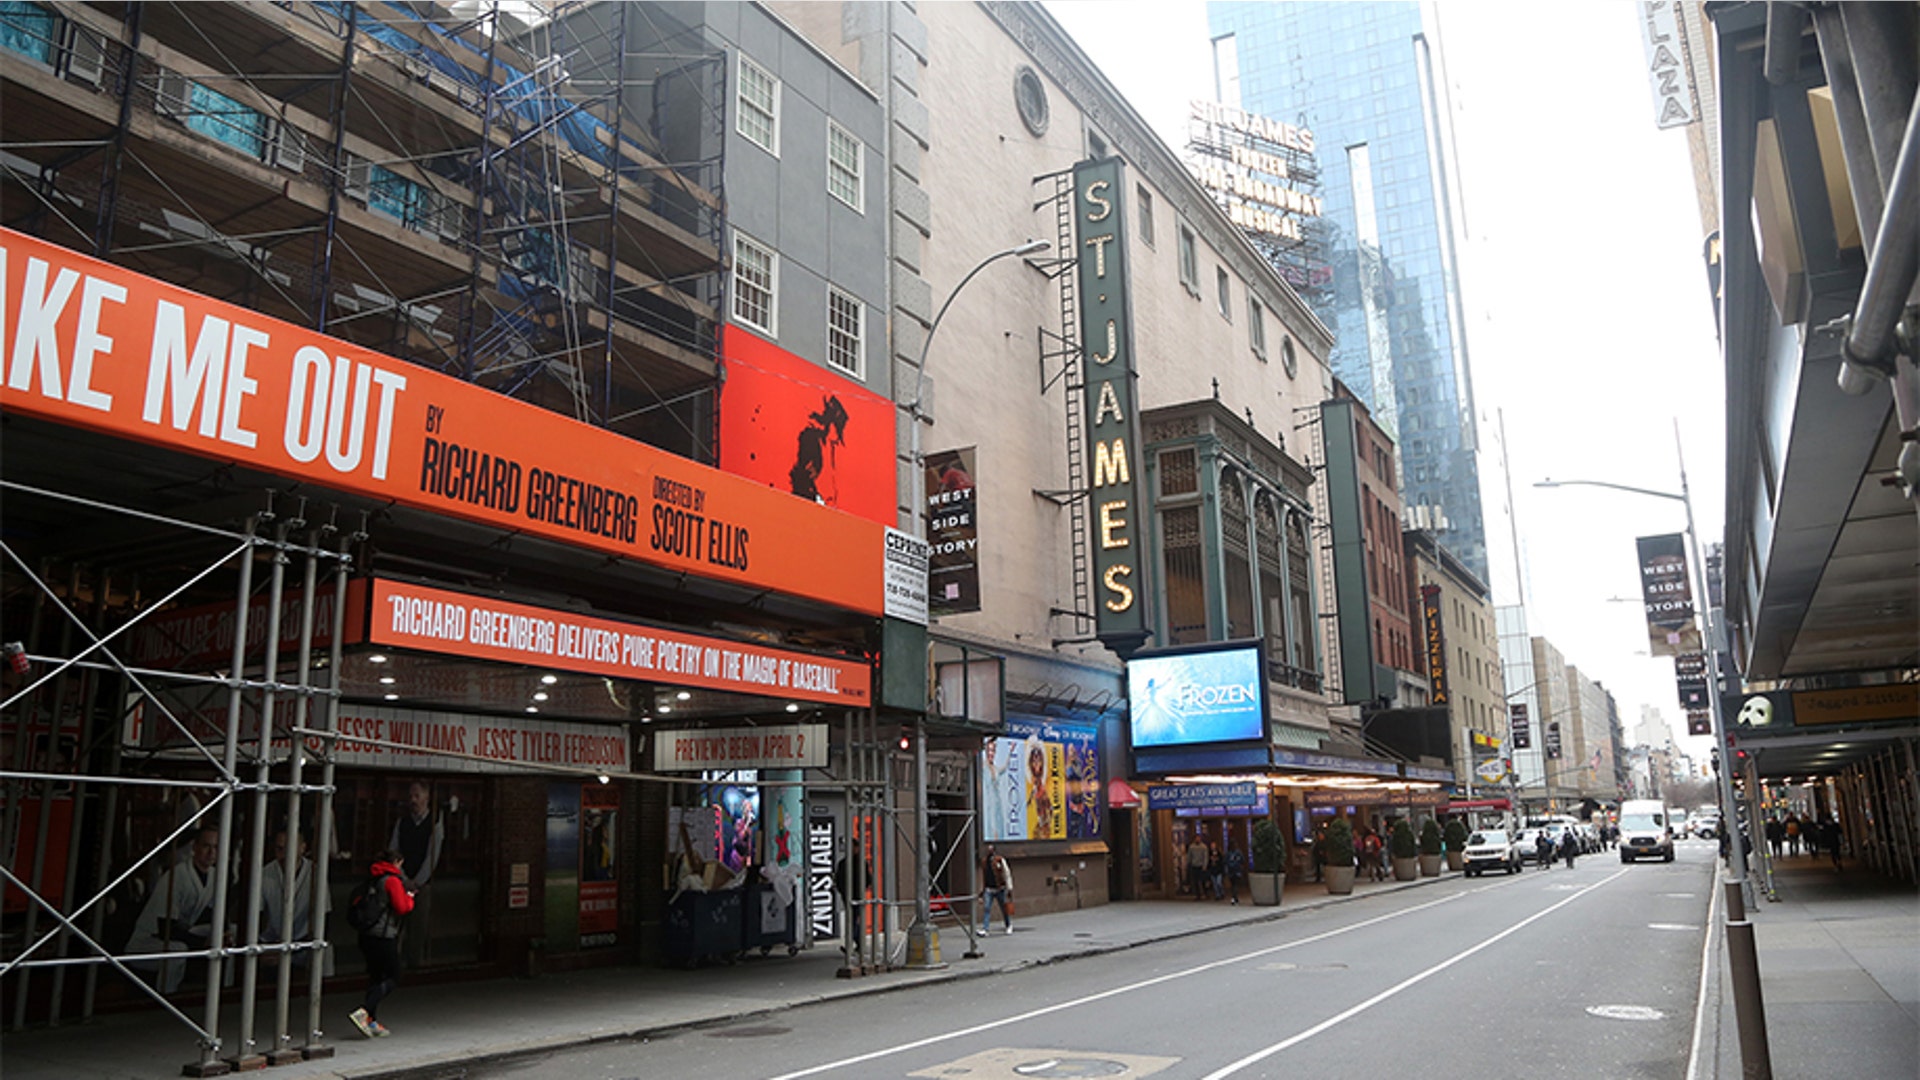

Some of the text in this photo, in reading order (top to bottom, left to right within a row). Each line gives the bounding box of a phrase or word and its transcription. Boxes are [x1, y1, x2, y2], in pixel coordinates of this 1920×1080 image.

[1232, 110, 1316, 153] JAMES
[1234, 174, 1323, 217] BROADWAY
[1230, 202, 1304, 241] MUSICAL
[142, 300, 270, 449] ME
[284, 345, 407, 481] OUT
[426, 404, 444, 435] BY
[1093, 319, 1134, 613] JAMES
[420, 437, 638, 544] RICHARD GREENBERG
[653, 475, 705, 512] DIRECTED BY
[929, 488, 972, 506] WEST
[651, 503, 750, 572] SCOTT ELLIS
[931, 514, 969, 531] SIDE
[928, 538, 977, 557] STORY
[1643, 562, 1684, 576] WEST
[1648, 581, 1685, 594] SIDE
[1646, 600, 1693, 613] STORY
[469, 608, 556, 655] GREENBERG
[557, 623, 619, 665] DELIVERS
[622, 633, 655, 669] PURE
[657, 640, 703, 676] POETRY
[704, 646, 719, 678] ON
[722, 650, 741, 681] THE
[743, 653, 777, 686] MAGIC
[778, 659, 791, 687] OF
[1427, 607, 1447, 702] PIZZERIA
[1180, 682, 1256, 710] FROZEN
[335, 716, 384, 753] JESSE
[388, 721, 467, 757] WILLIAMS
[473, 727, 518, 761] JESSE
[521, 730, 562, 764] TYLER
[563, 733, 626, 767] FERGUSON
[674, 733, 805, 762] PREVIEWS BEGIN APRIL 2
[1008, 741, 1020, 837] FROZEN
[1151, 784, 1253, 799] GREAT SEATS AVAILABLE
